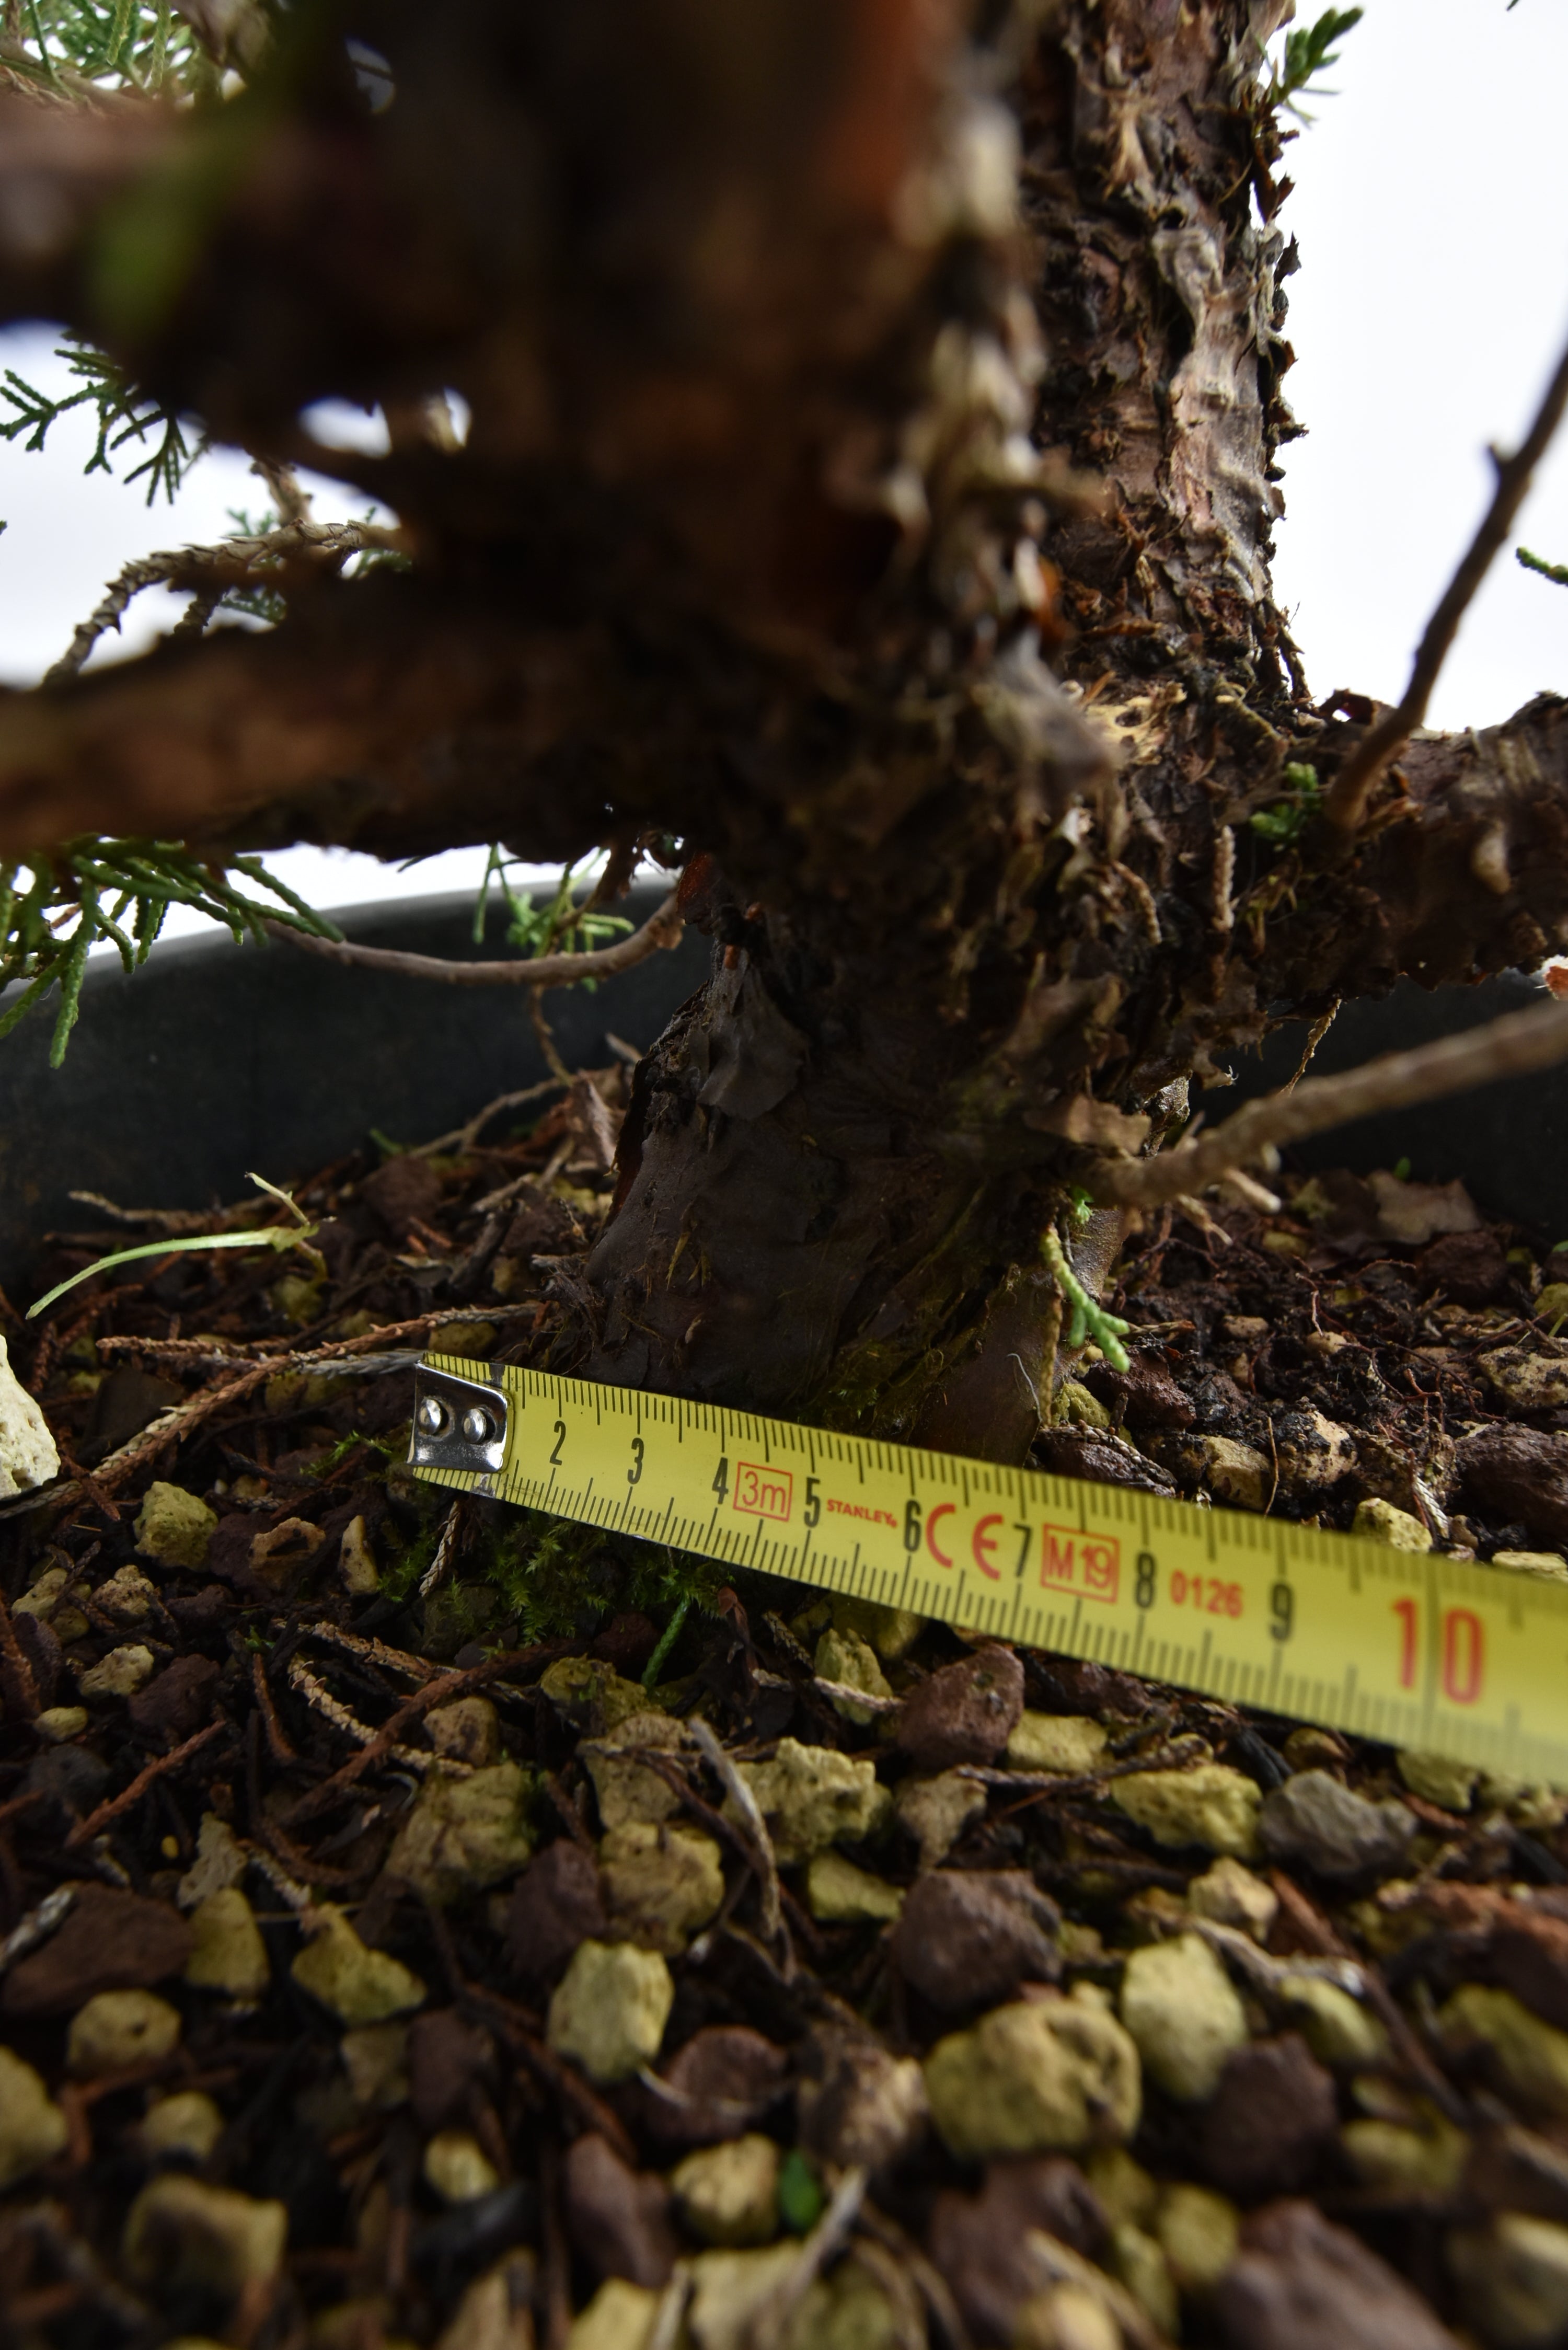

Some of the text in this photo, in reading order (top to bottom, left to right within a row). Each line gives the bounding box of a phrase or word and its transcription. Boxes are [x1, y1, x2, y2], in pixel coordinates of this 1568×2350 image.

[549, 1420, 566, 1466] 2
[627, 1437, 644, 1484] 3
[712, 1457, 729, 1504] 4
[742, 1470, 787, 1514] 3m
[804, 1477, 821, 1528] 5
[904, 1500, 922, 1553] 6
[926, 1503, 1004, 1581] CE
[1013, 1524, 1032, 1577] 7
[1135, 1552, 1156, 1609] 8
[1169, 1570, 1243, 1618] 0126
[1269, 1583, 1294, 1641] 9
[1391, 1597, 1484, 1704] 10
